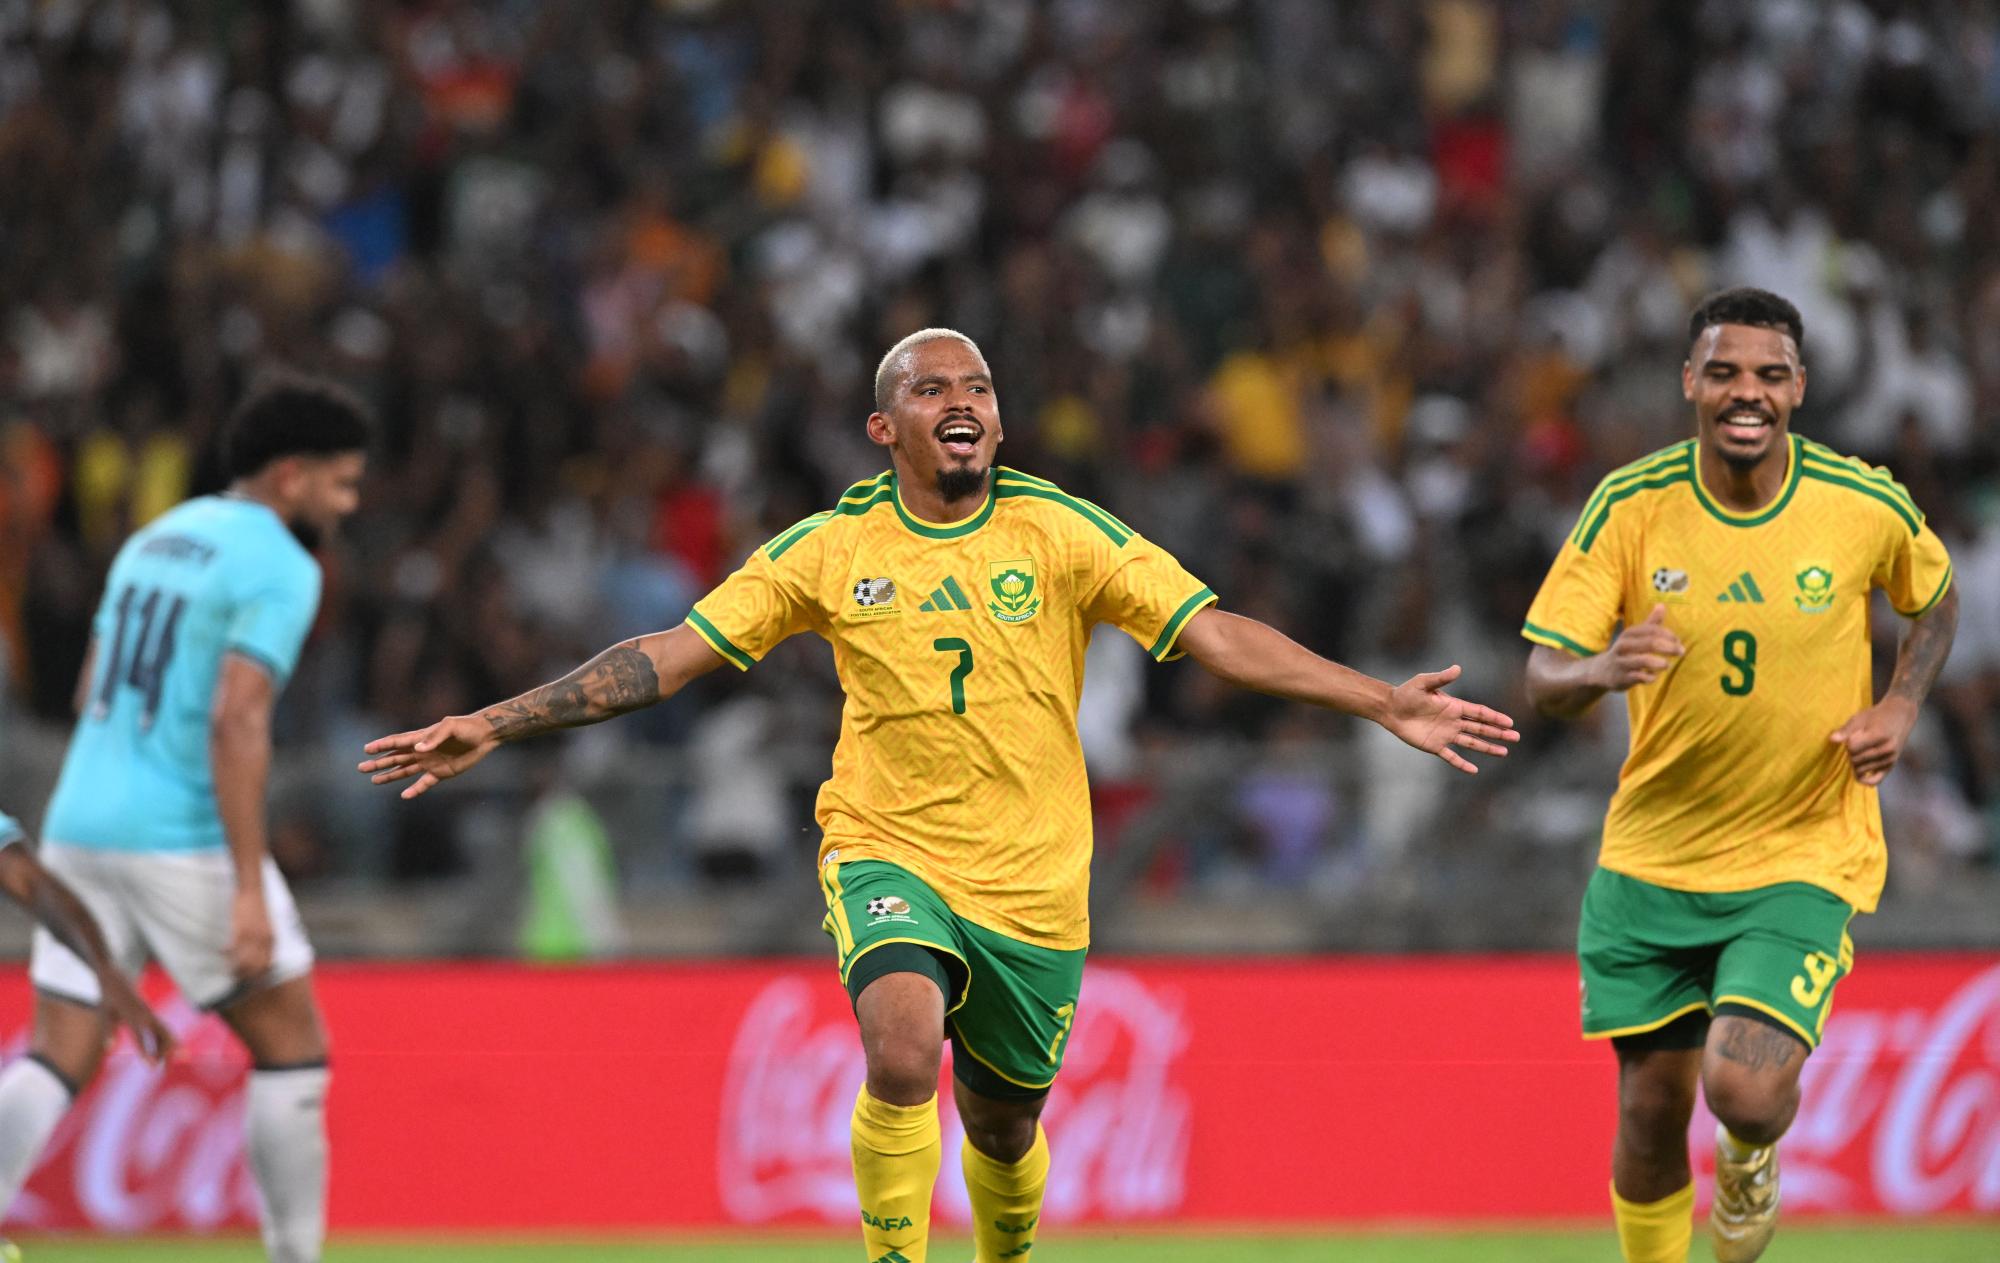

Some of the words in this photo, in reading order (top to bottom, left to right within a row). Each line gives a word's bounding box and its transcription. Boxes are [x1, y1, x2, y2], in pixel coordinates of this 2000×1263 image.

[996, 612, 1014, 621] SOUTH
[1015, 610, 1034, 621] AFRICA
[101, 585, 184, 718] 14
[933, 637, 974, 715] 7
[1720, 628, 1758, 697] 9
[1790, 951, 1838, 1008] 9
[1049, 1002, 1074, 1065] 7
[861, 1209, 913, 1232] SAFA
[994, 1215, 1038, 1234] SAF
